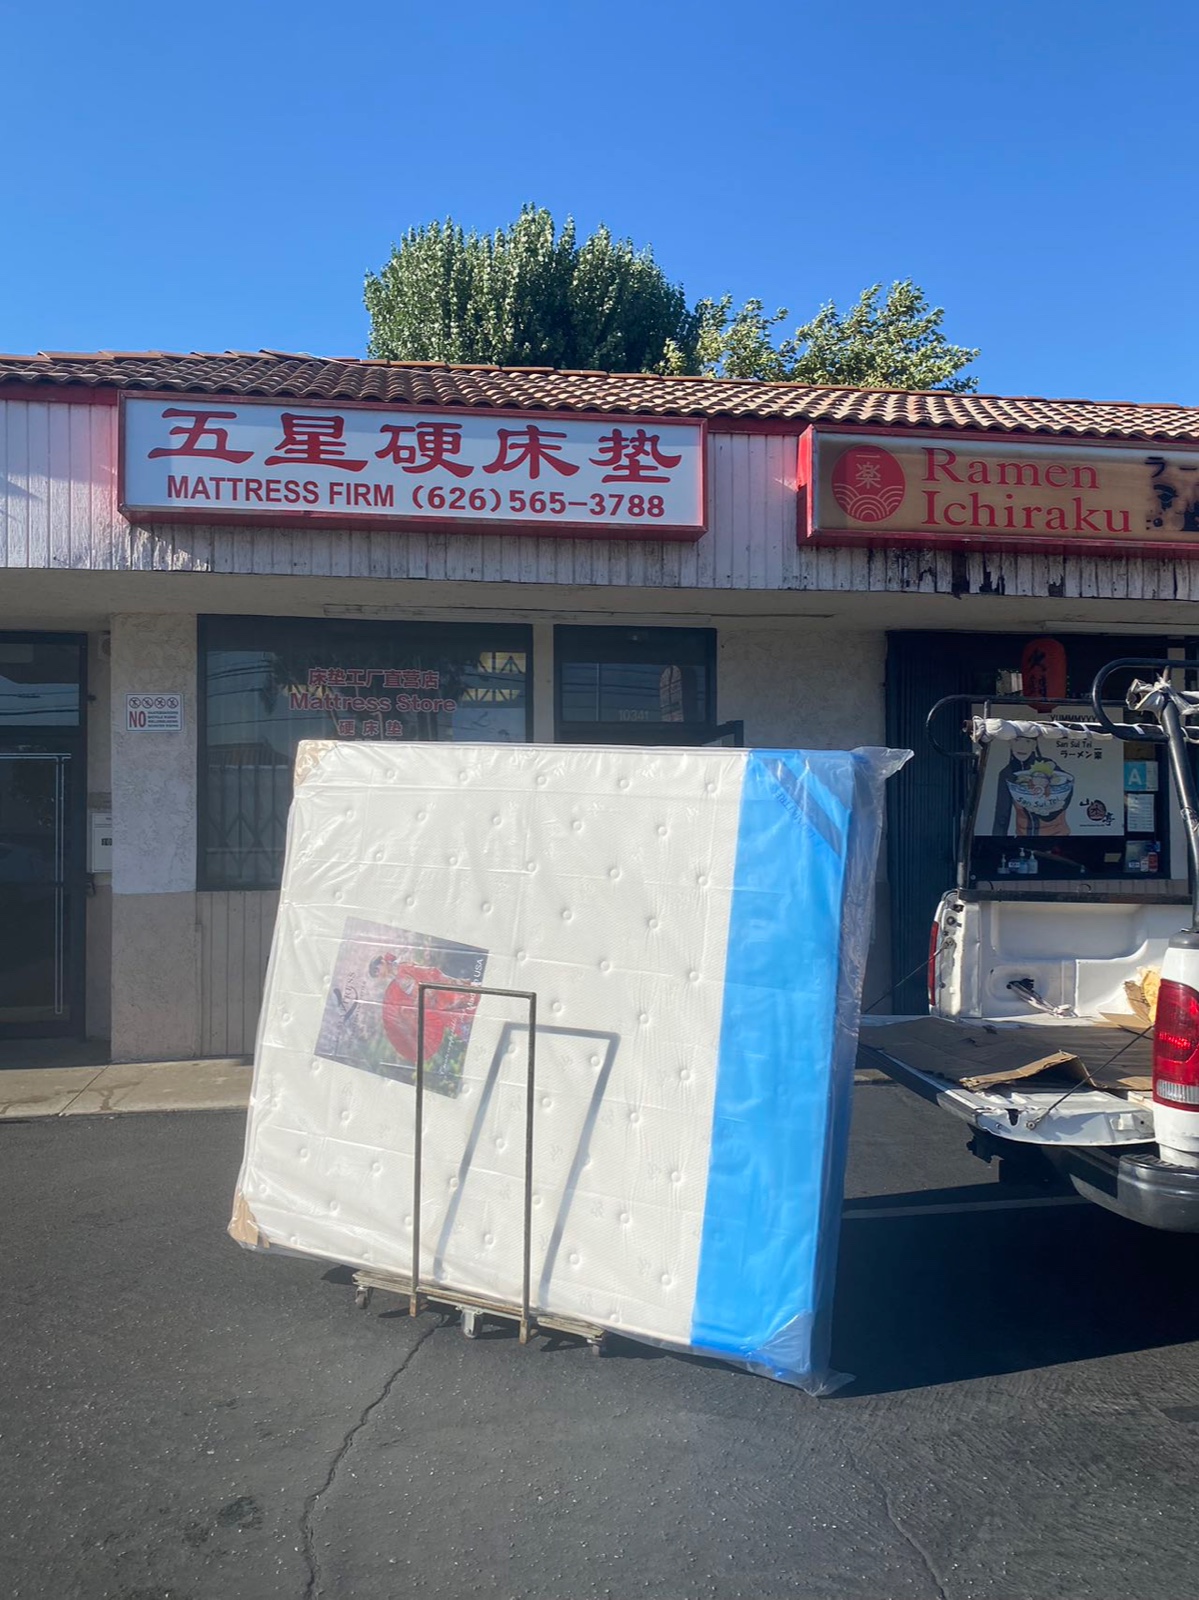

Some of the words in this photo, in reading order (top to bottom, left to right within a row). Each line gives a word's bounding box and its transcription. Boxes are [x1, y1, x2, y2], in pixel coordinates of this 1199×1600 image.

[148, 406, 682, 484] 五星硬床垫
[921, 446, 1099, 490] Ramen
[166, 474, 320, 504] MATTRESS
[328, 481, 395, 508] FIRM
[921, 490, 1132, 534] Ichiraku
[307, 667, 440, 690] 床垫工厂直营店
[288, 692, 392, 712] Mattress
[396, 694, 457, 713] Store
[129, 710, 147, 728] NO
[339, 719, 403, 737] 硬床垫
[1128, 769, 1142, 785] A
[472, 957, 484, 977] USA
